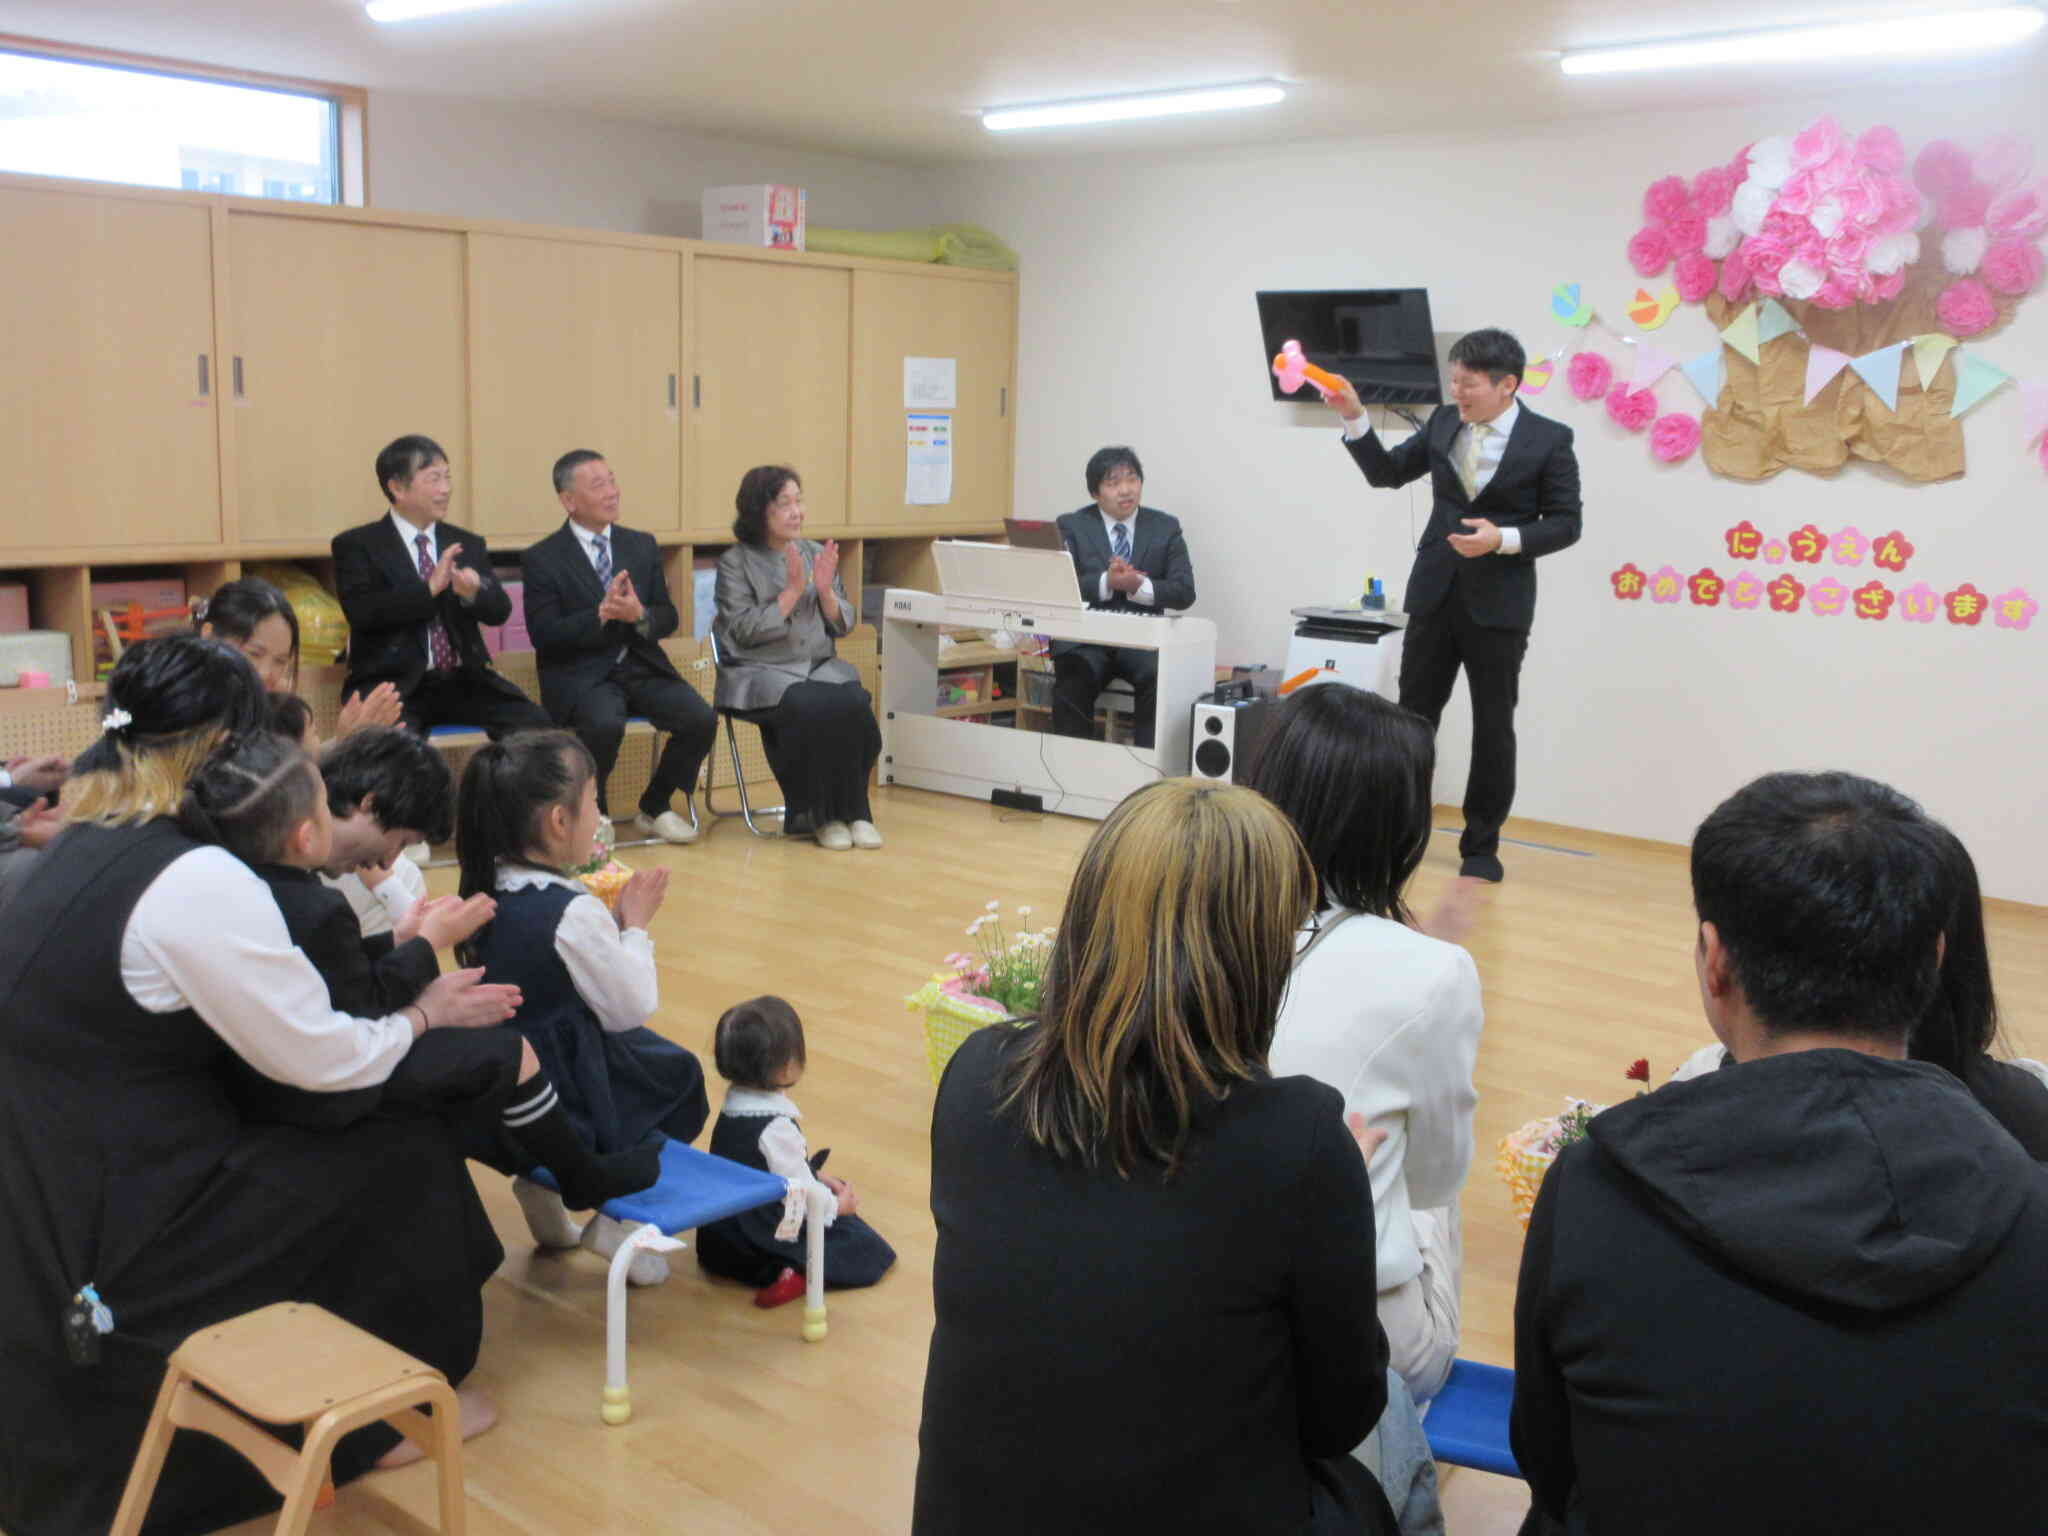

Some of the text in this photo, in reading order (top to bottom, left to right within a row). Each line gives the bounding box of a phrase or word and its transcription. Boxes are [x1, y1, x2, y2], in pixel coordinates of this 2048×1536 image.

[1618, 571, 2029, 621] おめでとうございます
